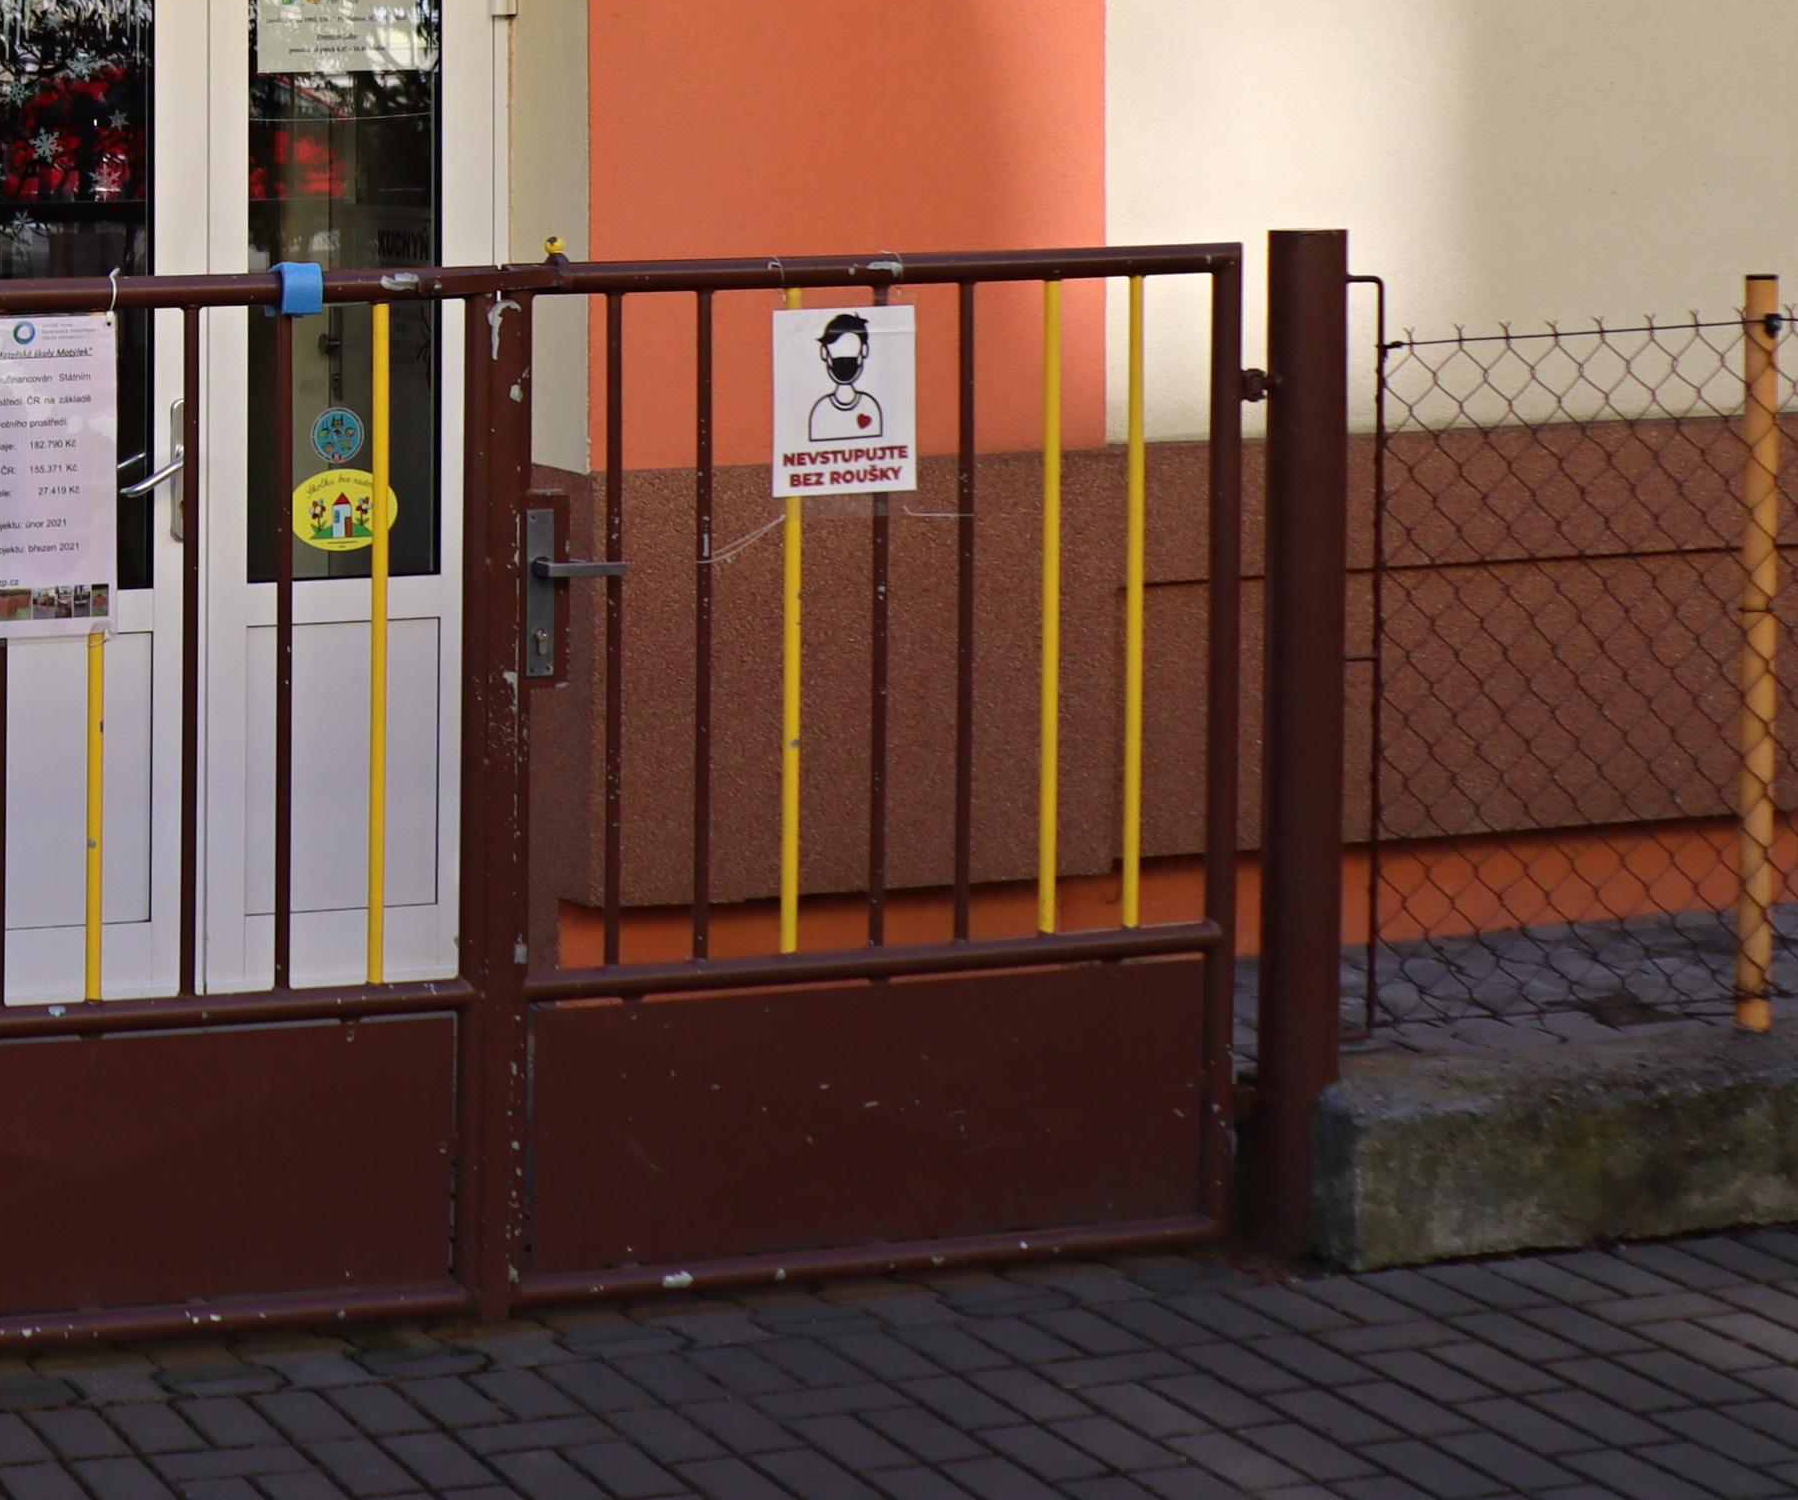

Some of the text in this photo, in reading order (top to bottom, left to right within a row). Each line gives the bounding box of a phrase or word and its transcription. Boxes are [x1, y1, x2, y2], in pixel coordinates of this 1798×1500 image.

[59, 373, 91, 382] Státním
[26, 396, 40, 405] ČR
[59, 395, 91, 404] základě
[30, 440, 63, 449] 182.790
[65, 439, 76, 448] Kč
[783, 446, 908, 467] NEVSTUPUJTE
[1, 465, 15, 475] ČR:
[30, 465, 62, 474] 155.371
[66, 464, 77, 472] Kč
[790, 465, 903, 487] BEZ ROUŠKY
[38, 487, 66, 496] 27.419
[69, 486, 79, 494] Kč
[26, 520, 44, 529] únor
[47, 519, 66, 528] 2021
[28, 543, 57, 553] březen
[60, 542, 79, 551] 2021
